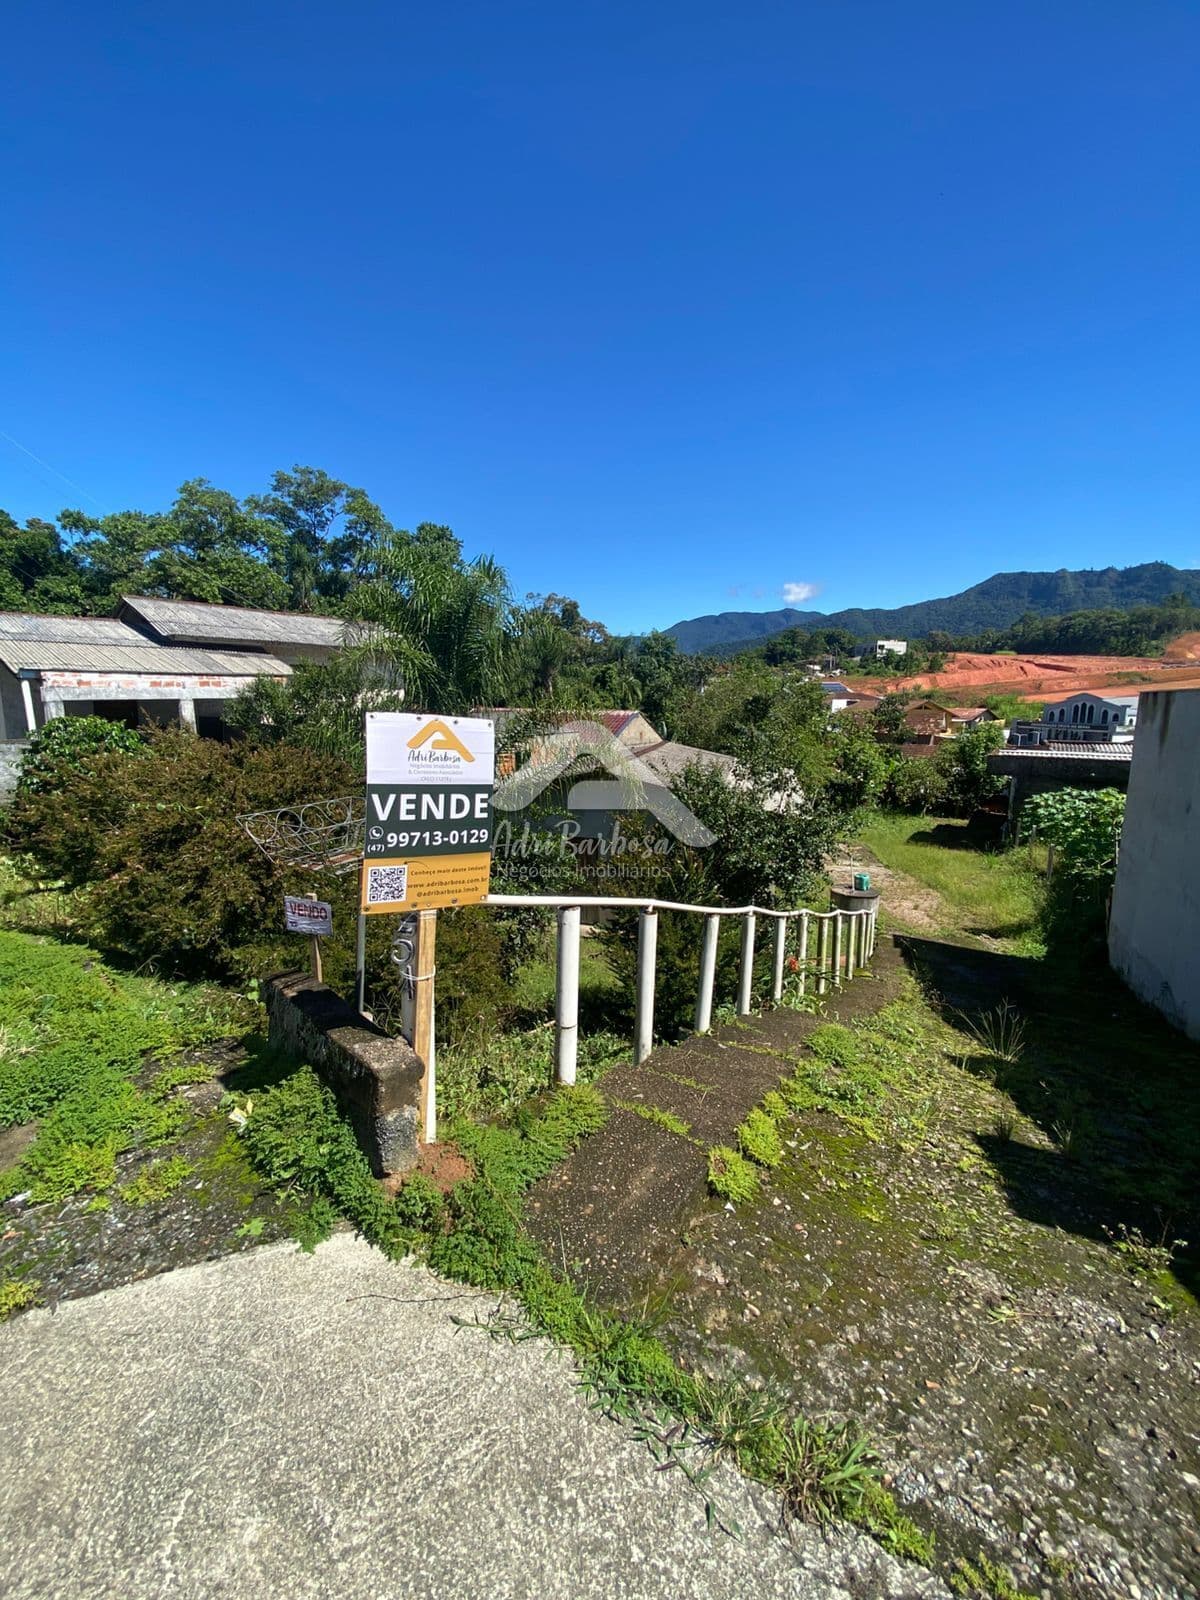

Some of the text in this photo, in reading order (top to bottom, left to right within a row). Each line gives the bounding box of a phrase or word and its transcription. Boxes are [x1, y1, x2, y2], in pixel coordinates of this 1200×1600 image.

[371, 793, 489, 821] VENDE
[386, 829, 489, 848] 99713-0129
[367, 844, 385, 853] (47)
[407, 876, 488, 889] www.adribarbosa.com.br
[416, 886, 479, 898] @adribarbosa.imob
[290, 902, 328, 920] VENDO
